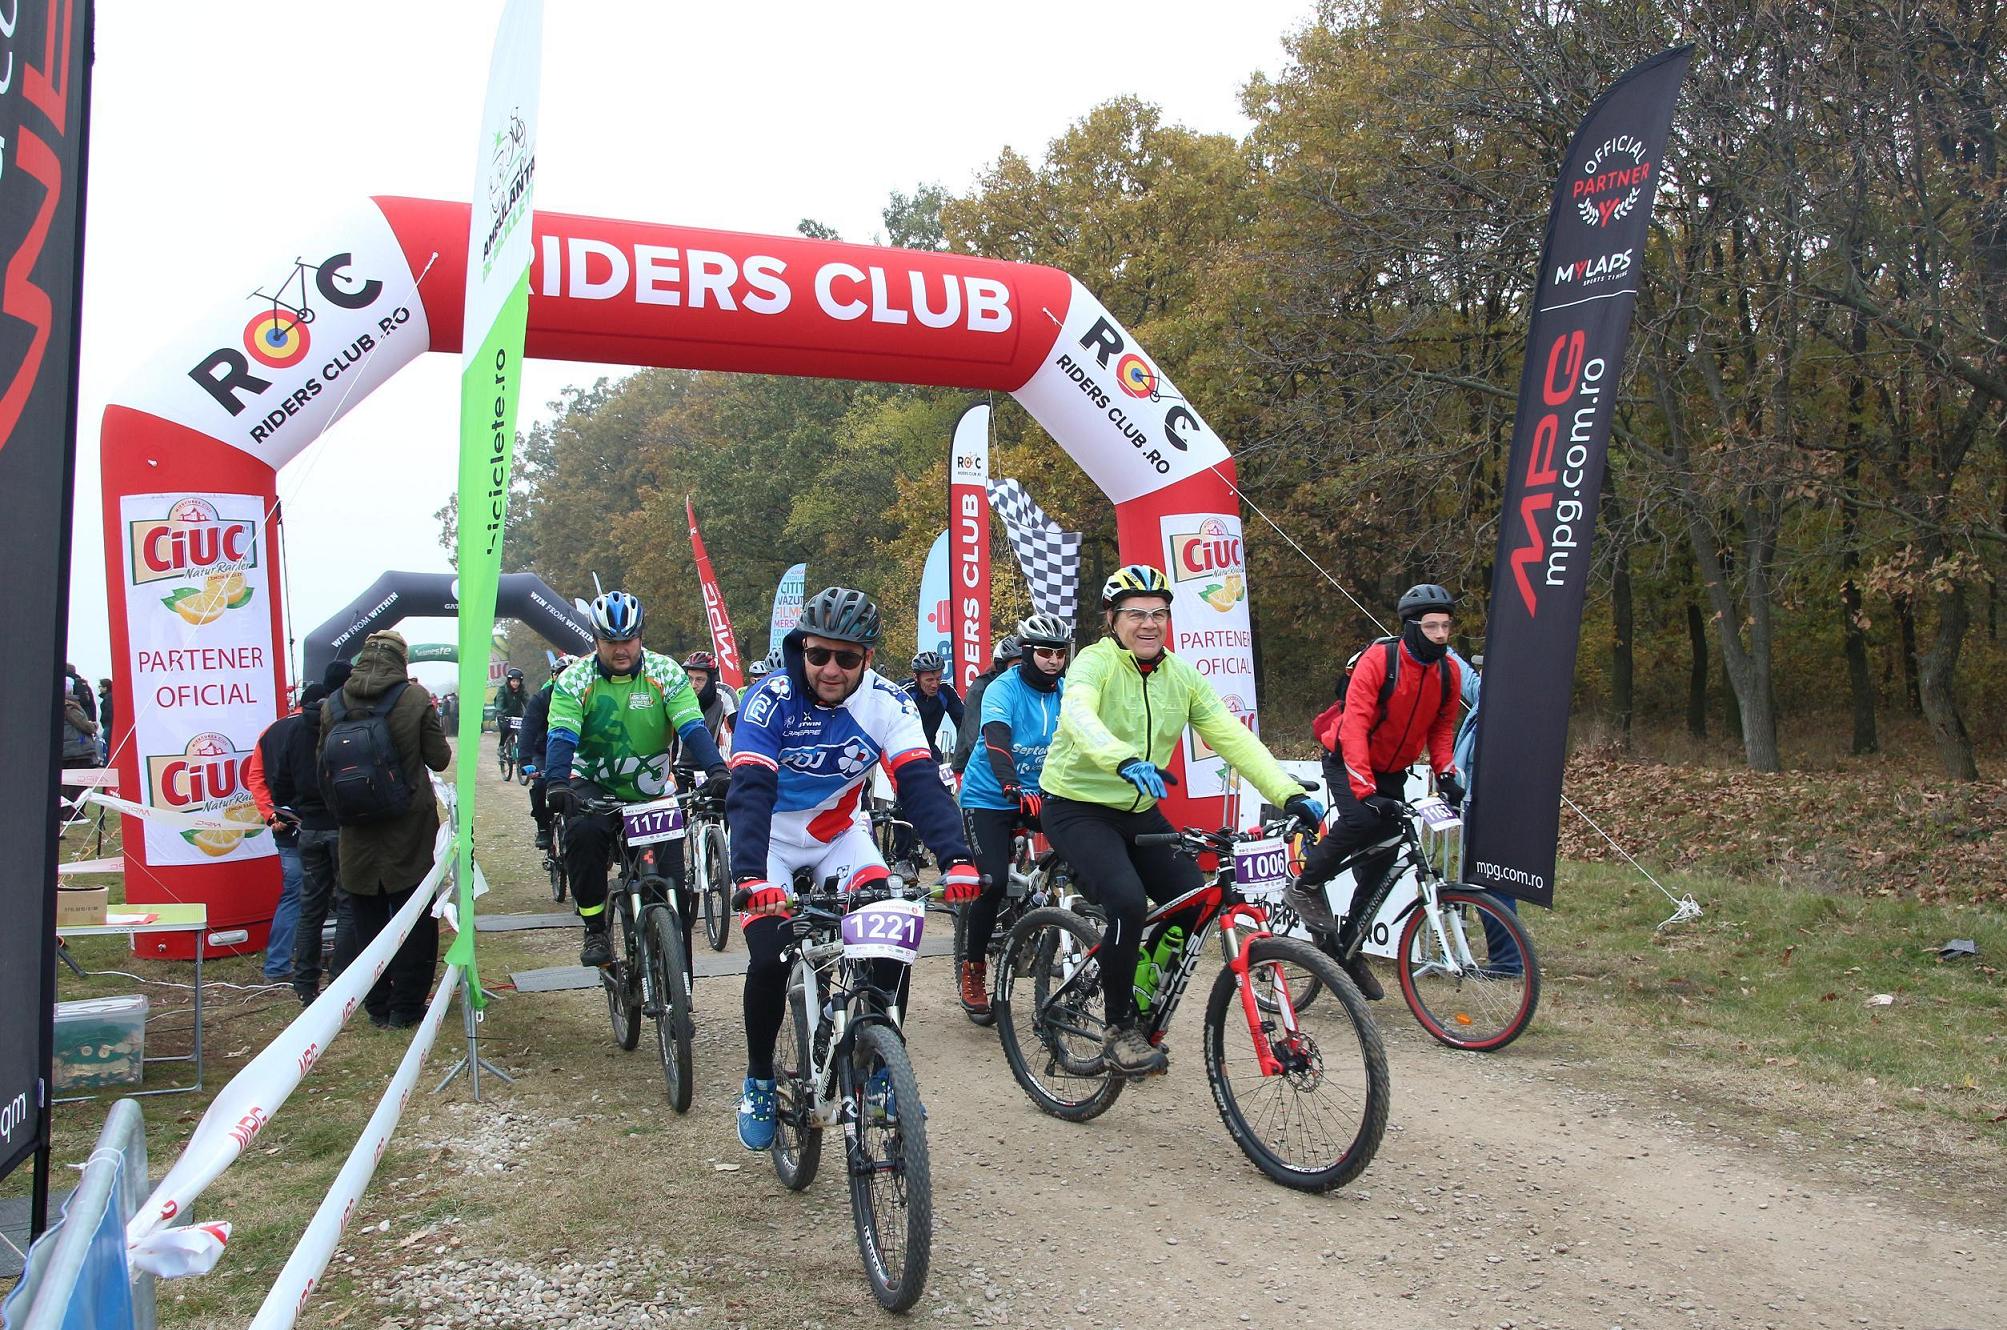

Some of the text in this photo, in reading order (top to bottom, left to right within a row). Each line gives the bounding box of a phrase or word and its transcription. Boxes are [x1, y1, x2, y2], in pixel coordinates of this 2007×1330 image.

[1584, 135, 1647, 174] OFFICIAL
[1573, 162, 1651, 198] PARTNER
[530, 235, 1013, 333] IDERS CLUB
[1554, 249, 1633, 286] MYLAPS
[249, 378, 323, 444] RIDERS
[322, 333, 376, 381] CLUB
[1056, 354, 1110, 409] RIDERS
[1107, 407, 1148, 449] CLUB
[1510, 329, 1586, 618] MPG
[1546, 357, 1606, 586] mpg.com.ro
[962, 493, 980, 588] CLUB
[331, 591, 399, 648] WIN FROM WITHIN
[530, 591, 594, 643] WIN FROM WITHIN
[138, 646, 264, 673] PARTENER
[1196, 657, 1252, 676] OFICIAL
[156, 683, 258, 709] OFICIAL
[630, 810, 675, 833] 1177
[1242, 852, 1285, 879] 1006
[1476, 860, 1544, 889] mpg.com.ro
[850, 913, 916, 943] 1221
